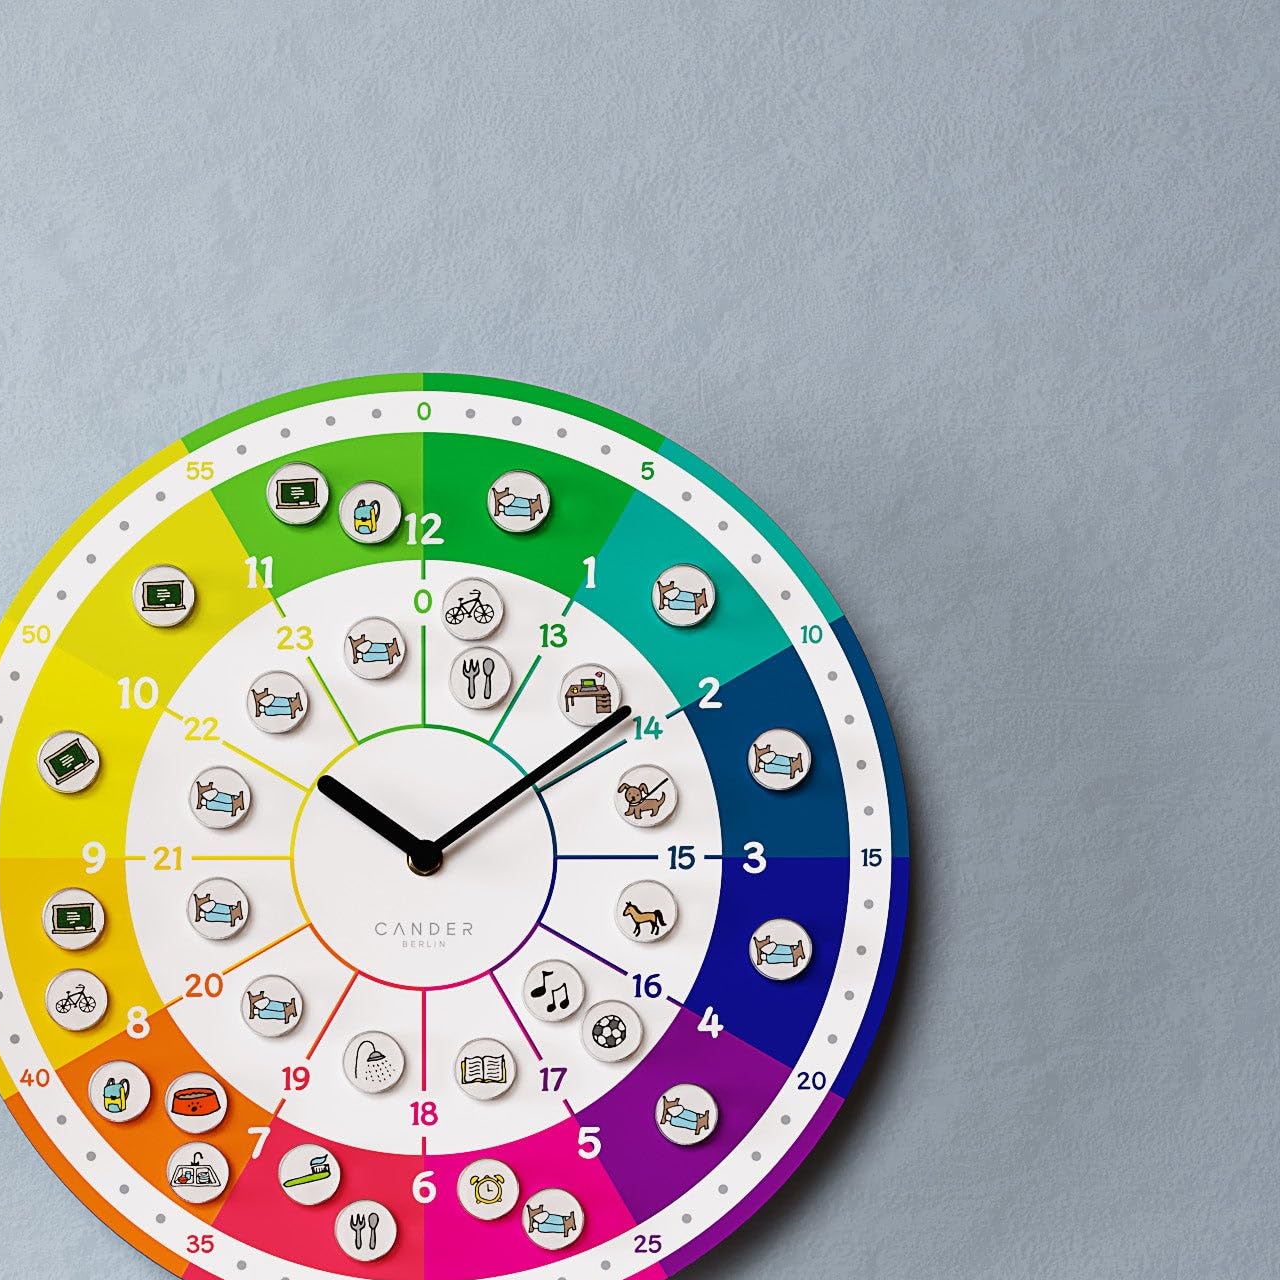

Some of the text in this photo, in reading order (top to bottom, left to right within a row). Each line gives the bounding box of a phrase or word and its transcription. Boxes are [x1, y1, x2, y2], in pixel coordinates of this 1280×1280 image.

[417, 403, 432, 421] 0
[186, 462, 215, 480] 55
[641, 462, 655, 480] 5
[404, 512, 445, 545] 12
[245, 556, 274, 588] 11
[582, 556, 596, 588] 1
[414, 589, 432, 614] 0
[22, 625, 51, 644] 50
[276, 626, 314, 650] 23
[539, 624, 568, 648] 13
[800, 625, 823, 643] 10
[117, 677, 158, 709] 10
[698, 677, 723, 709] 2
[184, 717, 220, 741] 22
[633, 716, 663, 740] 14
[81, 840, 106, 874] 9
[153, 848, 183, 871] 21
[668, 846, 696, 870] 15
[742, 841, 767, 874] 3
[861, 849, 882, 867] 15
[402, 940, 446, 948] BERLIN
[185, 973, 223, 997] 20
[632, 975, 663, 998] 16
[126, 1006, 150, 1039] 8
[697, 1006, 723, 1039] 4
[20, 1069, 50, 1087] 40
[282, 1067, 310, 1090] 19
[539, 1068, 568, 1091] 17
[797, 1072, 827, 1090] 20
[410, 1102, 439, 1126] 18
[247, 1126, 271, 1159] 7
[577, 1126, 601, 1159] 5
[412, 1171, 437, 1203] 6
[186, 1235, 215, 1253] 35
[633, 1235, 662, 1253] 25
